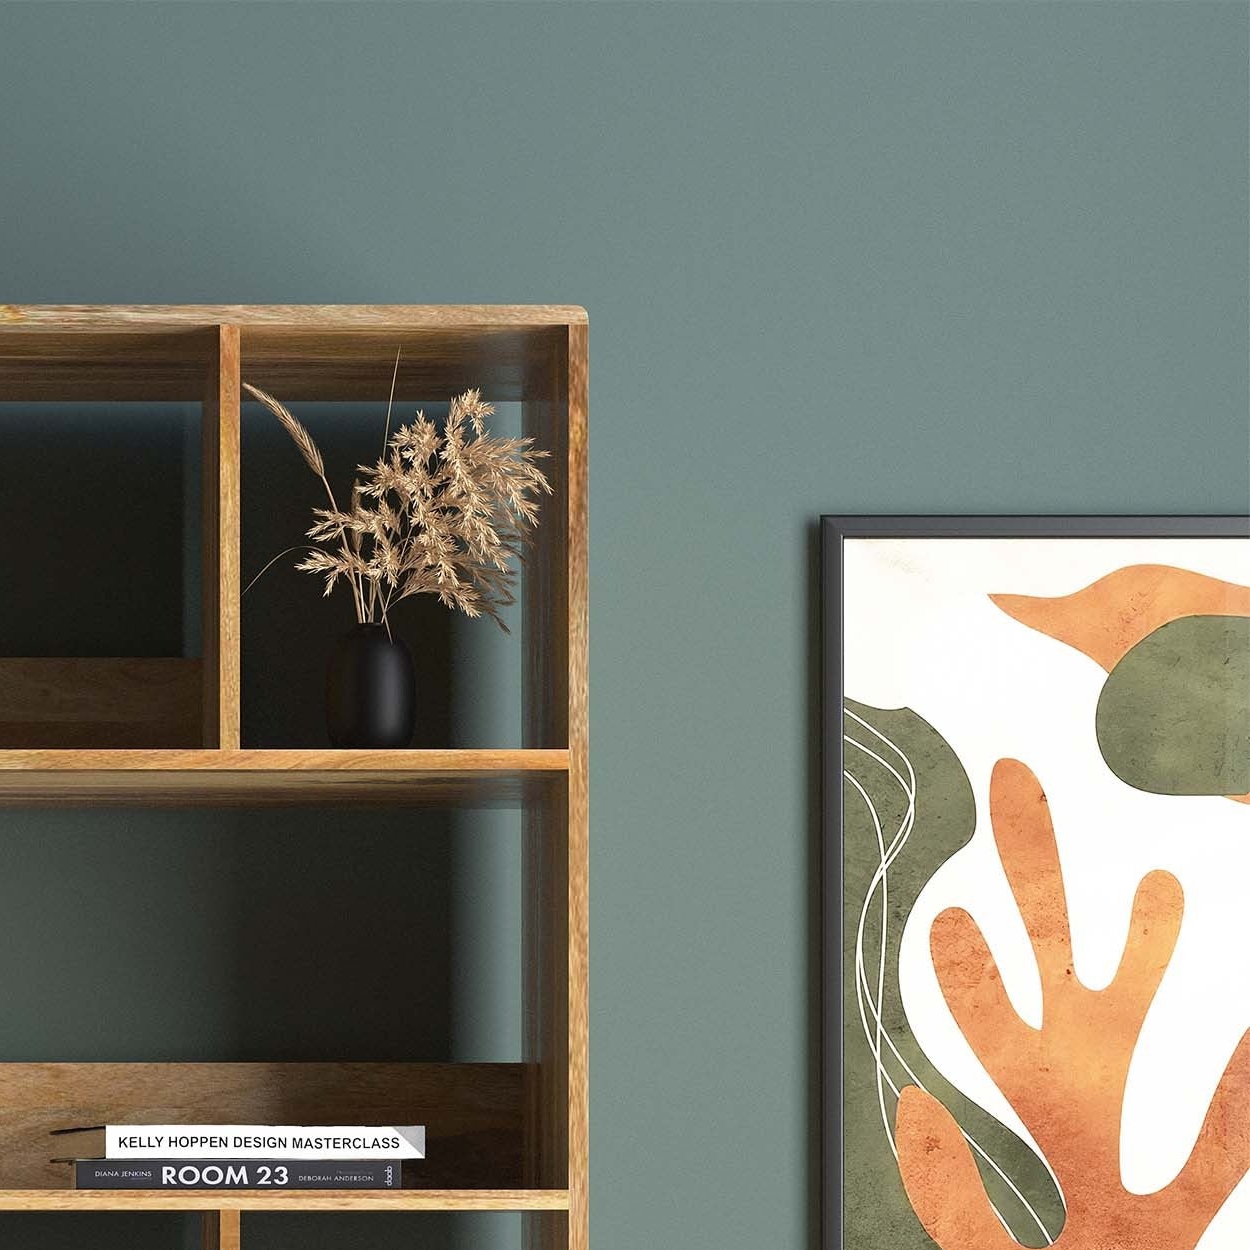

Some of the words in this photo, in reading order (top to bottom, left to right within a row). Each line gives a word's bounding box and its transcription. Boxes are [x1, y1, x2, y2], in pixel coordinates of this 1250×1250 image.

[118, 1136, 164, 1149] KELLY
[168, 1136, 228, 1149] HOPPEN
[233, 1136, 287, 1149] DESIGN
[292, 1136, 400, 1149] MASTERCLASS
[94, 1170, 119, 1178] DIANA
[121, 1170, 152, 1178] JENKINS
[161, 1165, 249, 1186] ROOM
[256, 1165, 289, 1186] 23
